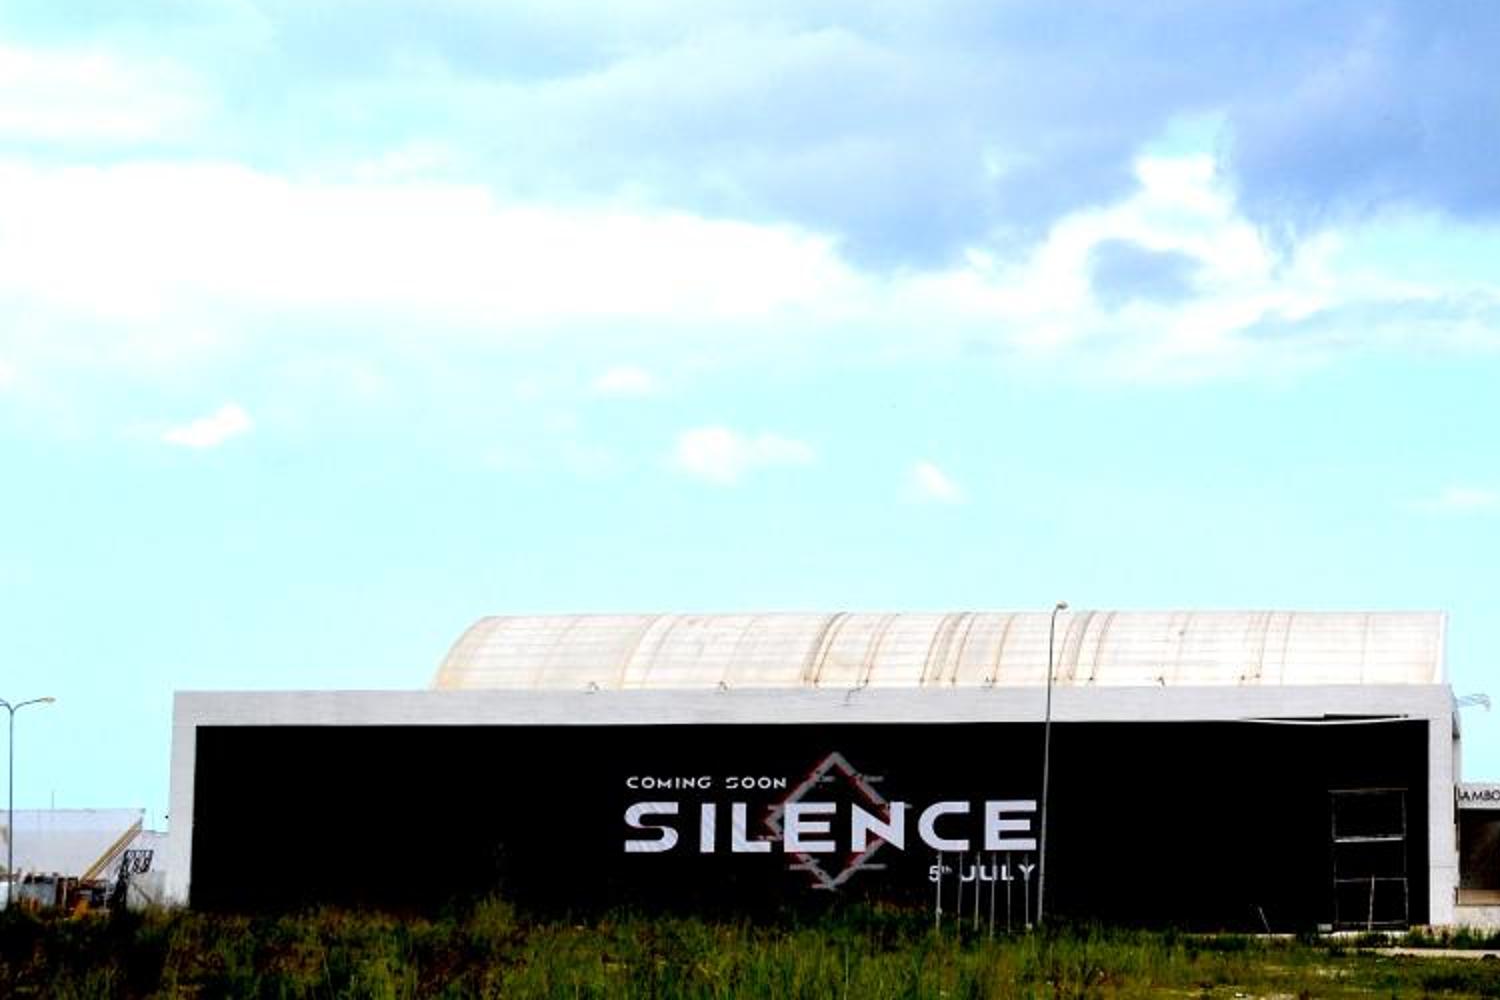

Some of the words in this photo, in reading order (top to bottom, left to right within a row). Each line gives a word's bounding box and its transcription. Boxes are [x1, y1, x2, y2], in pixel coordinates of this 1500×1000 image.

[626, 776, 712, 789] COMING
[725, 776, 787, 789] SOON
[624, 800, 1037, 853] SILENCE
[961, 864, 1035, 881] JULY
